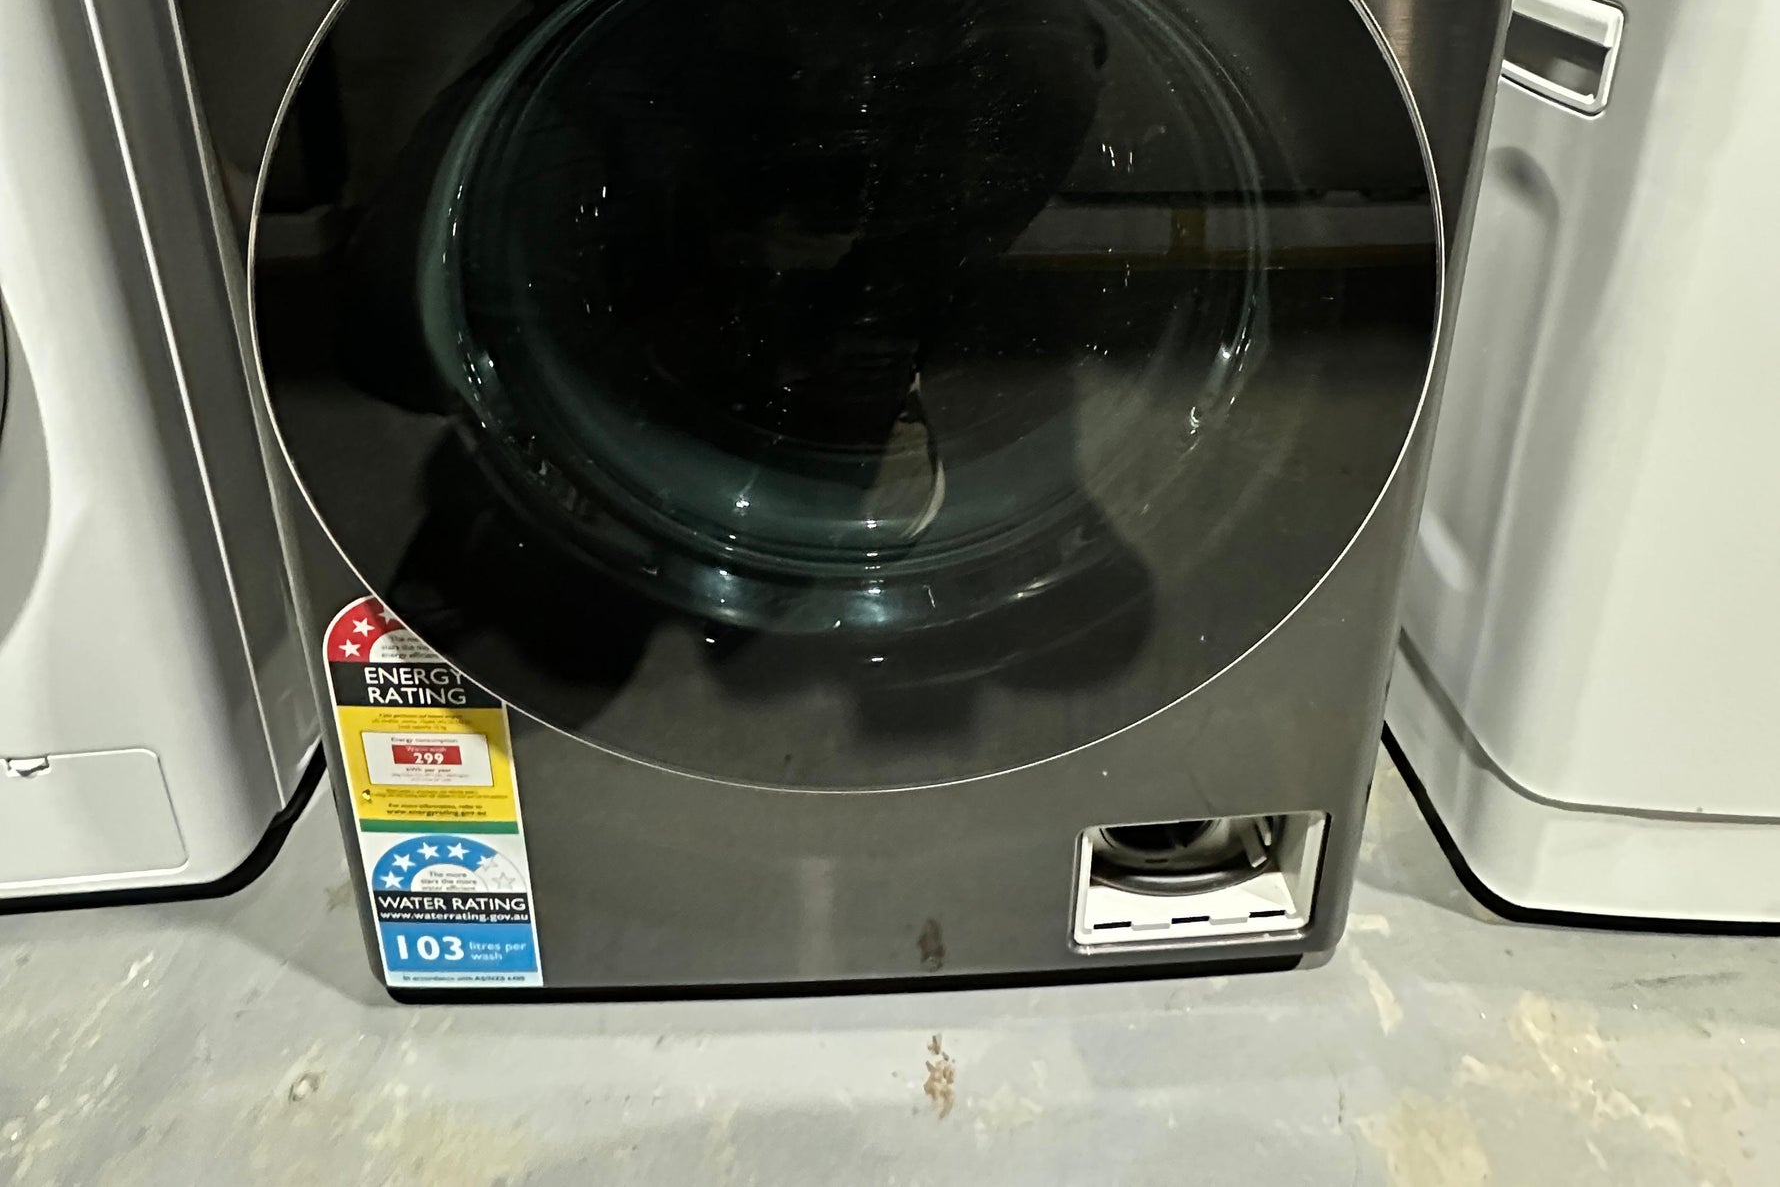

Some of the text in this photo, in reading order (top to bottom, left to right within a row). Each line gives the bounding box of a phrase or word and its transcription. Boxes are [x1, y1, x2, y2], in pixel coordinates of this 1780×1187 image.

[363, 666, 464, 685] ENERGY
[367, 687, 467, 704] RATING
[412, 752, 444, 765] 299
[378, 895, 526, 912] WATER RATING
[380, 911, 529, 923] www.waterrating.gov.au
[396, 934, 465, 961] 103
[469, 941, 527, 953] litres per
[471, 951, 503, 961] wash
